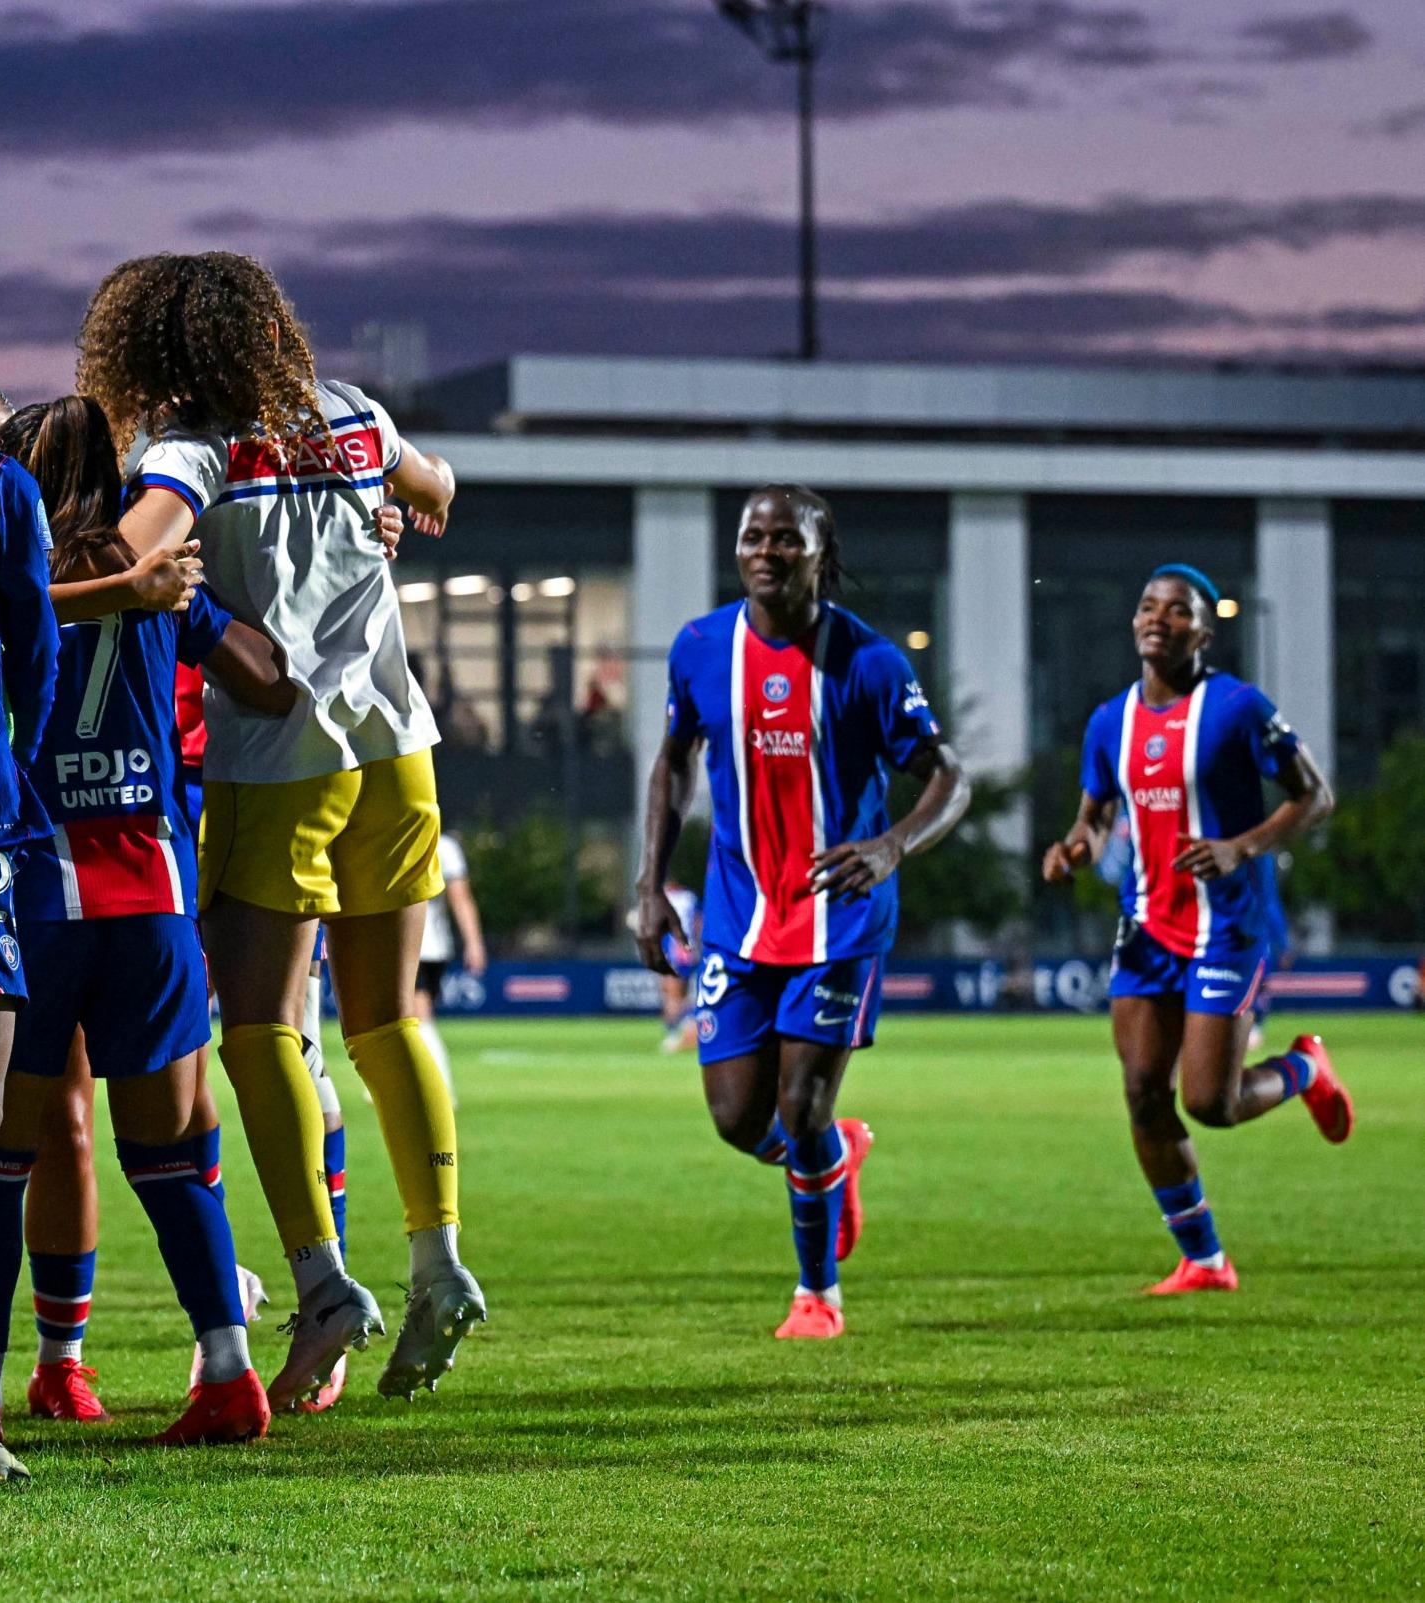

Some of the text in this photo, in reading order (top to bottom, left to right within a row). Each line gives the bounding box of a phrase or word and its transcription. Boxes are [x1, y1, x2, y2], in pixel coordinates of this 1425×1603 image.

[61, 611, 124, 740] 7
[748, 729, 805, 750] QATAR
[61, 784, 154, 809] UNITED
[430, 1152, 454, 1167] PARIS
